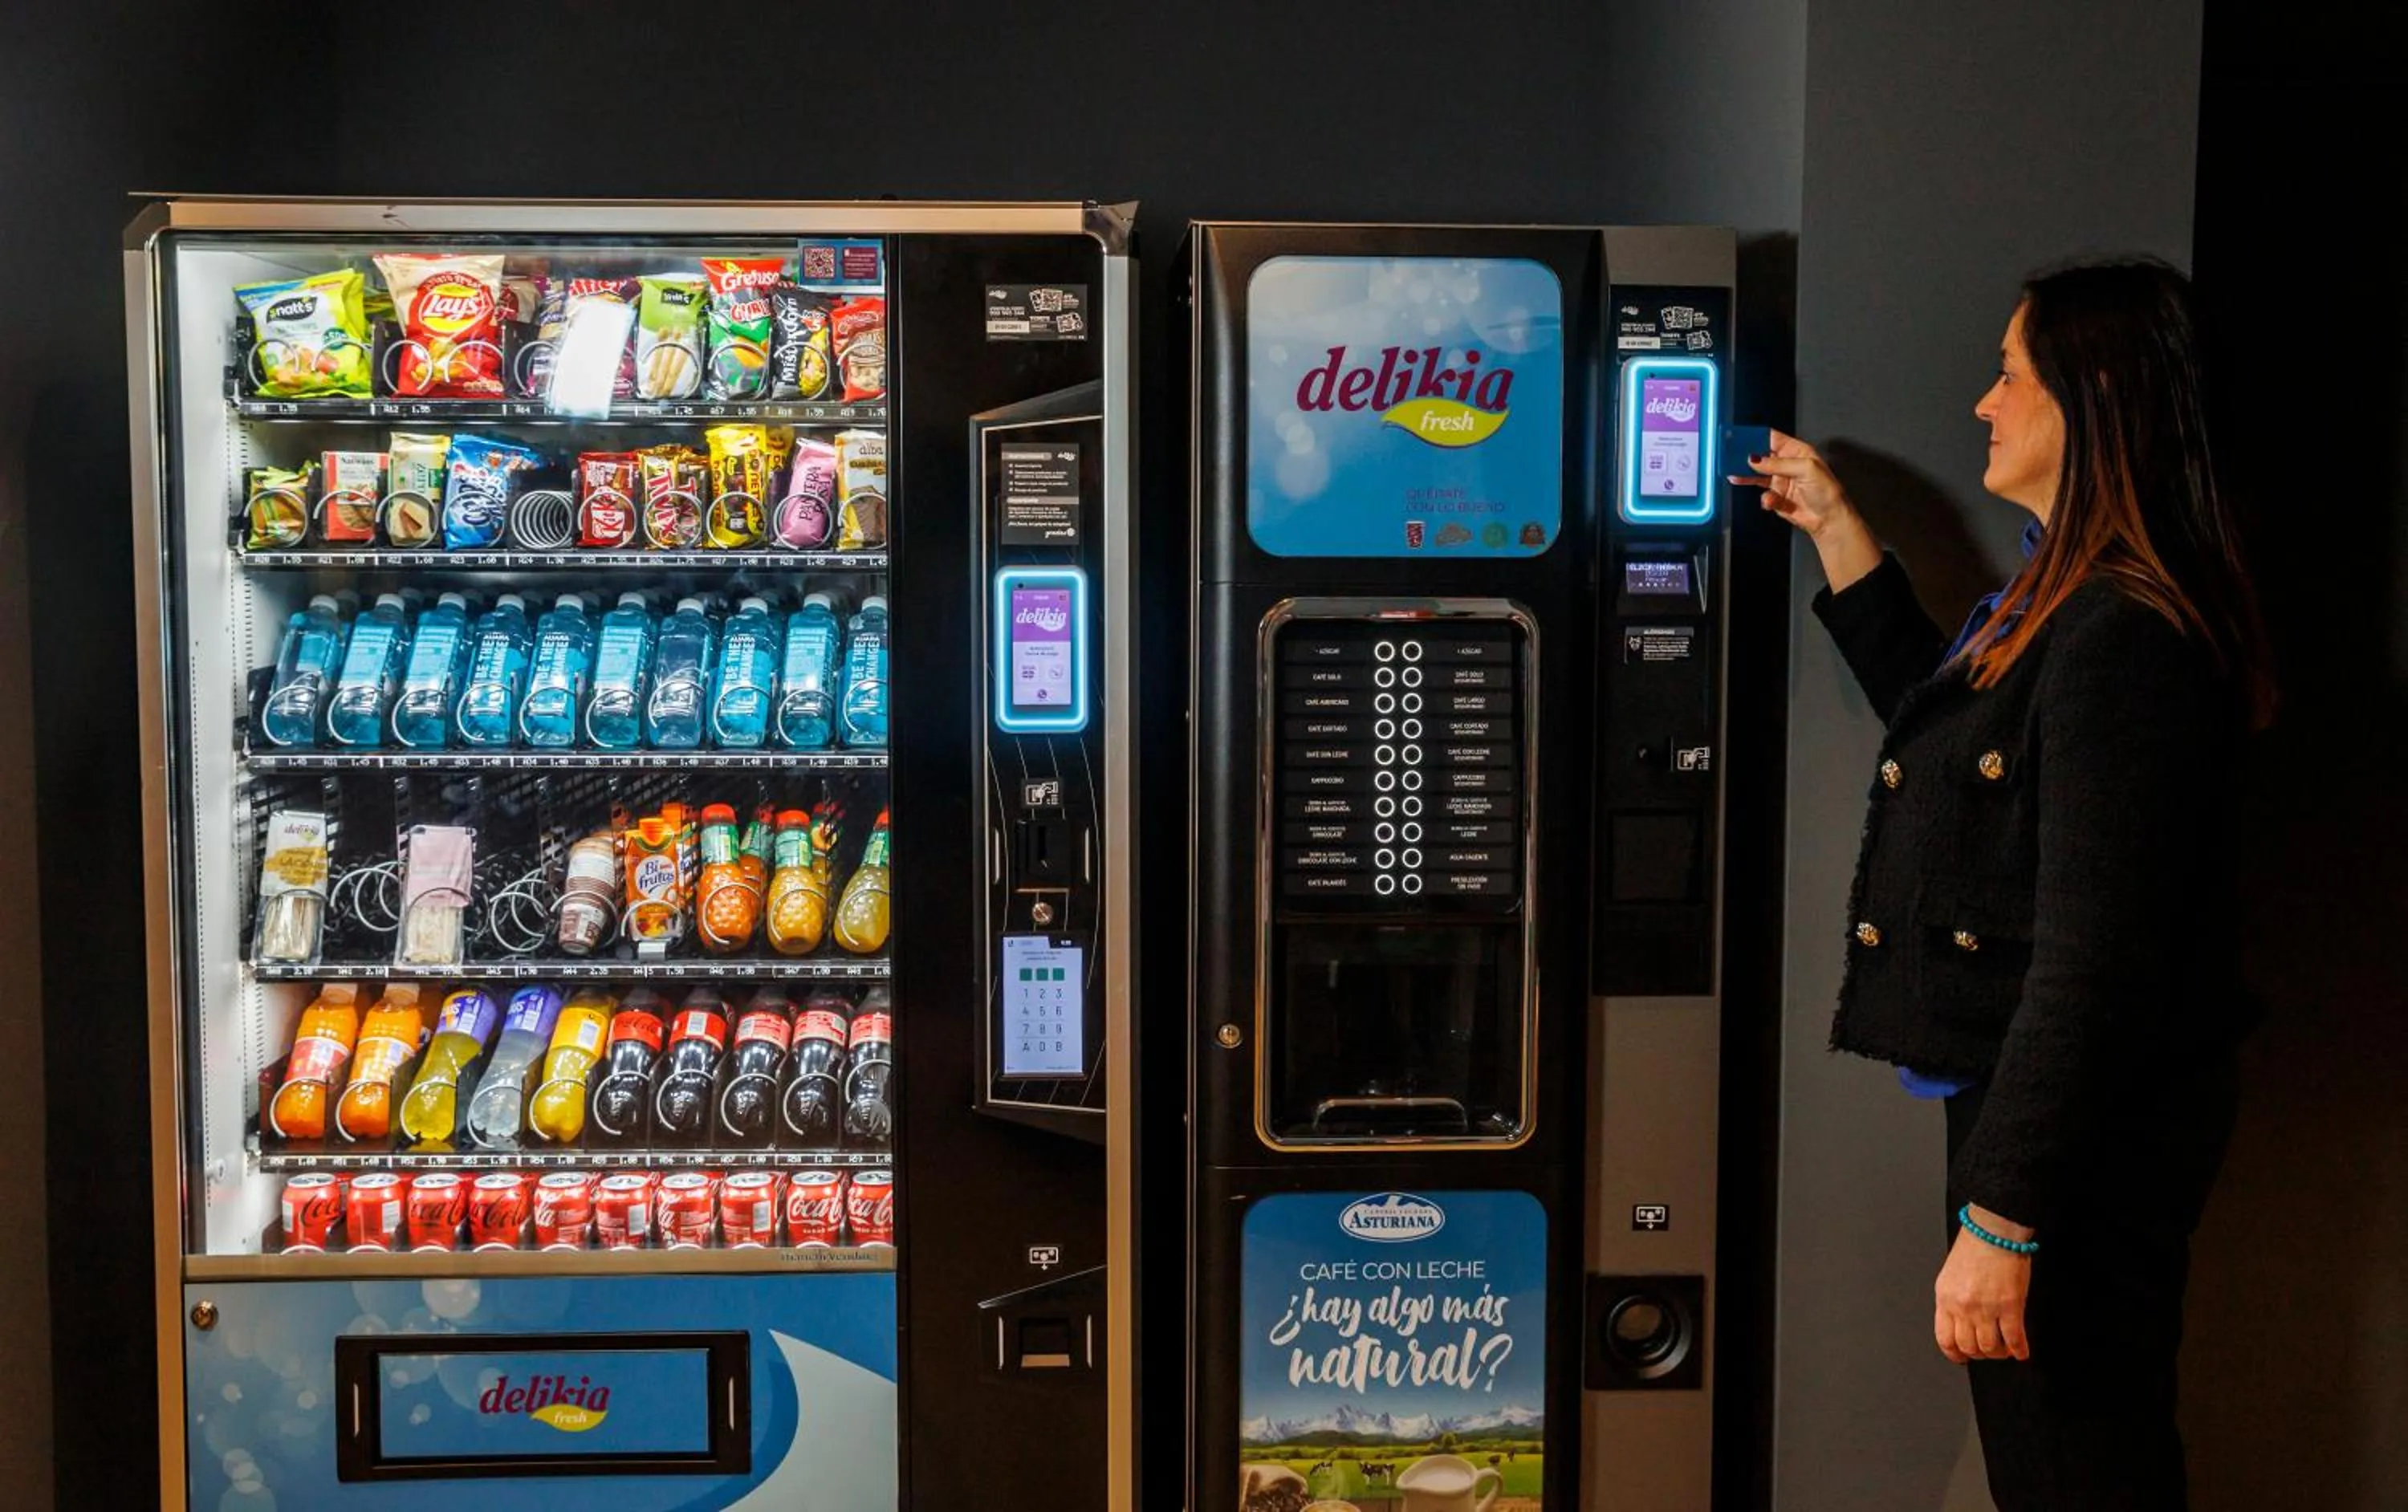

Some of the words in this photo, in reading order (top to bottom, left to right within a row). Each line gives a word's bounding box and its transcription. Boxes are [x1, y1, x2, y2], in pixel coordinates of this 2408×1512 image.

[1296, 346, 1515, 412] delikia
[1419, 410, 1475, 433] fresh
[1023, 989, 1028, 998] 1
[1039, 989, 1046, 999] 2
[1056, 989, 1062, 999] 3
[1039, 1006, 1046, 1016] 5
[1056, 1006, 1062, 1016] 6
[1023, 1023, 1029, 1034] 7
[1039, 1023, 1046, 1034] 8
[1056, 1023, 1062, 1034] 9
[1349, 1211, 1435, 1228] ASTURIANA
[1300, 1258, 1358, 1281] CAFÉ
[1362, 1262, 1410, 1280] CON
[1417, 1260, 1485, 1279] LECHE
[1269, 1286, 1362, 1346] ¿hay
[1368, 1285, 1435, 1336] algo
[1442, 1283, 1510, 1327] más
[1288, 1327, 1513, 1395] natural?
[478, 1375, 611, 1415] delikia
[554, 1411, 588, 1425] fresh
